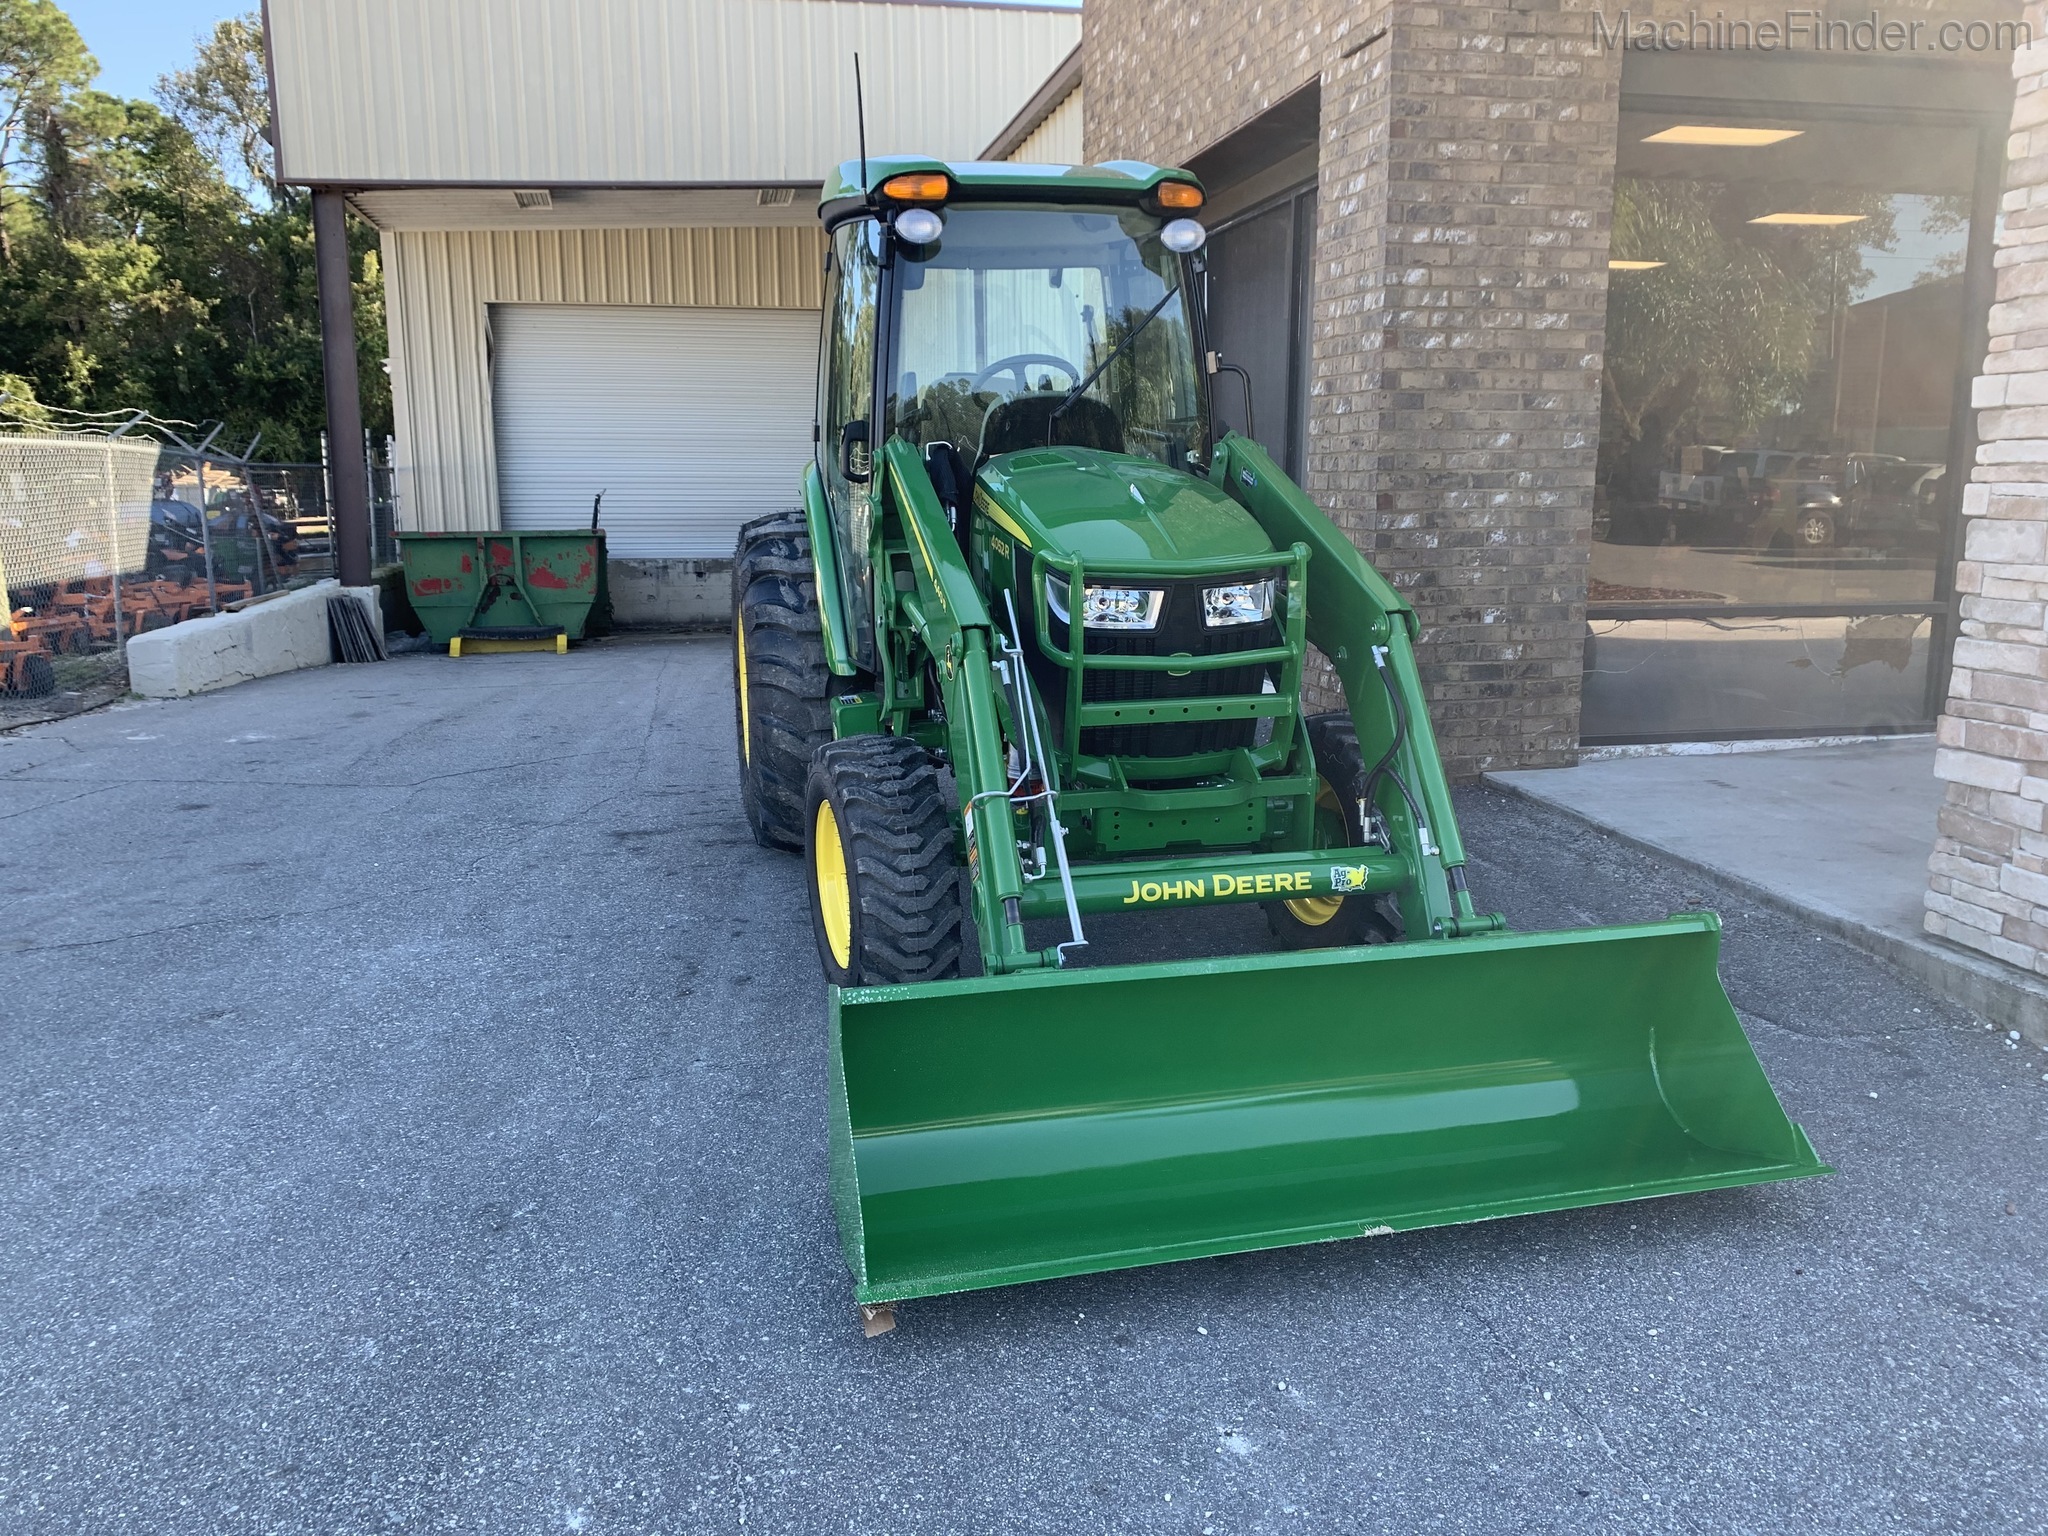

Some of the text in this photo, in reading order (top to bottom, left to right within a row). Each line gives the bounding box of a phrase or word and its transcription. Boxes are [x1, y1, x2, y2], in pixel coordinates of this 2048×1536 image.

[1123, 871, 1312, 904] JOHN DEERE
[1334, 878, 1352, 887] Pro
